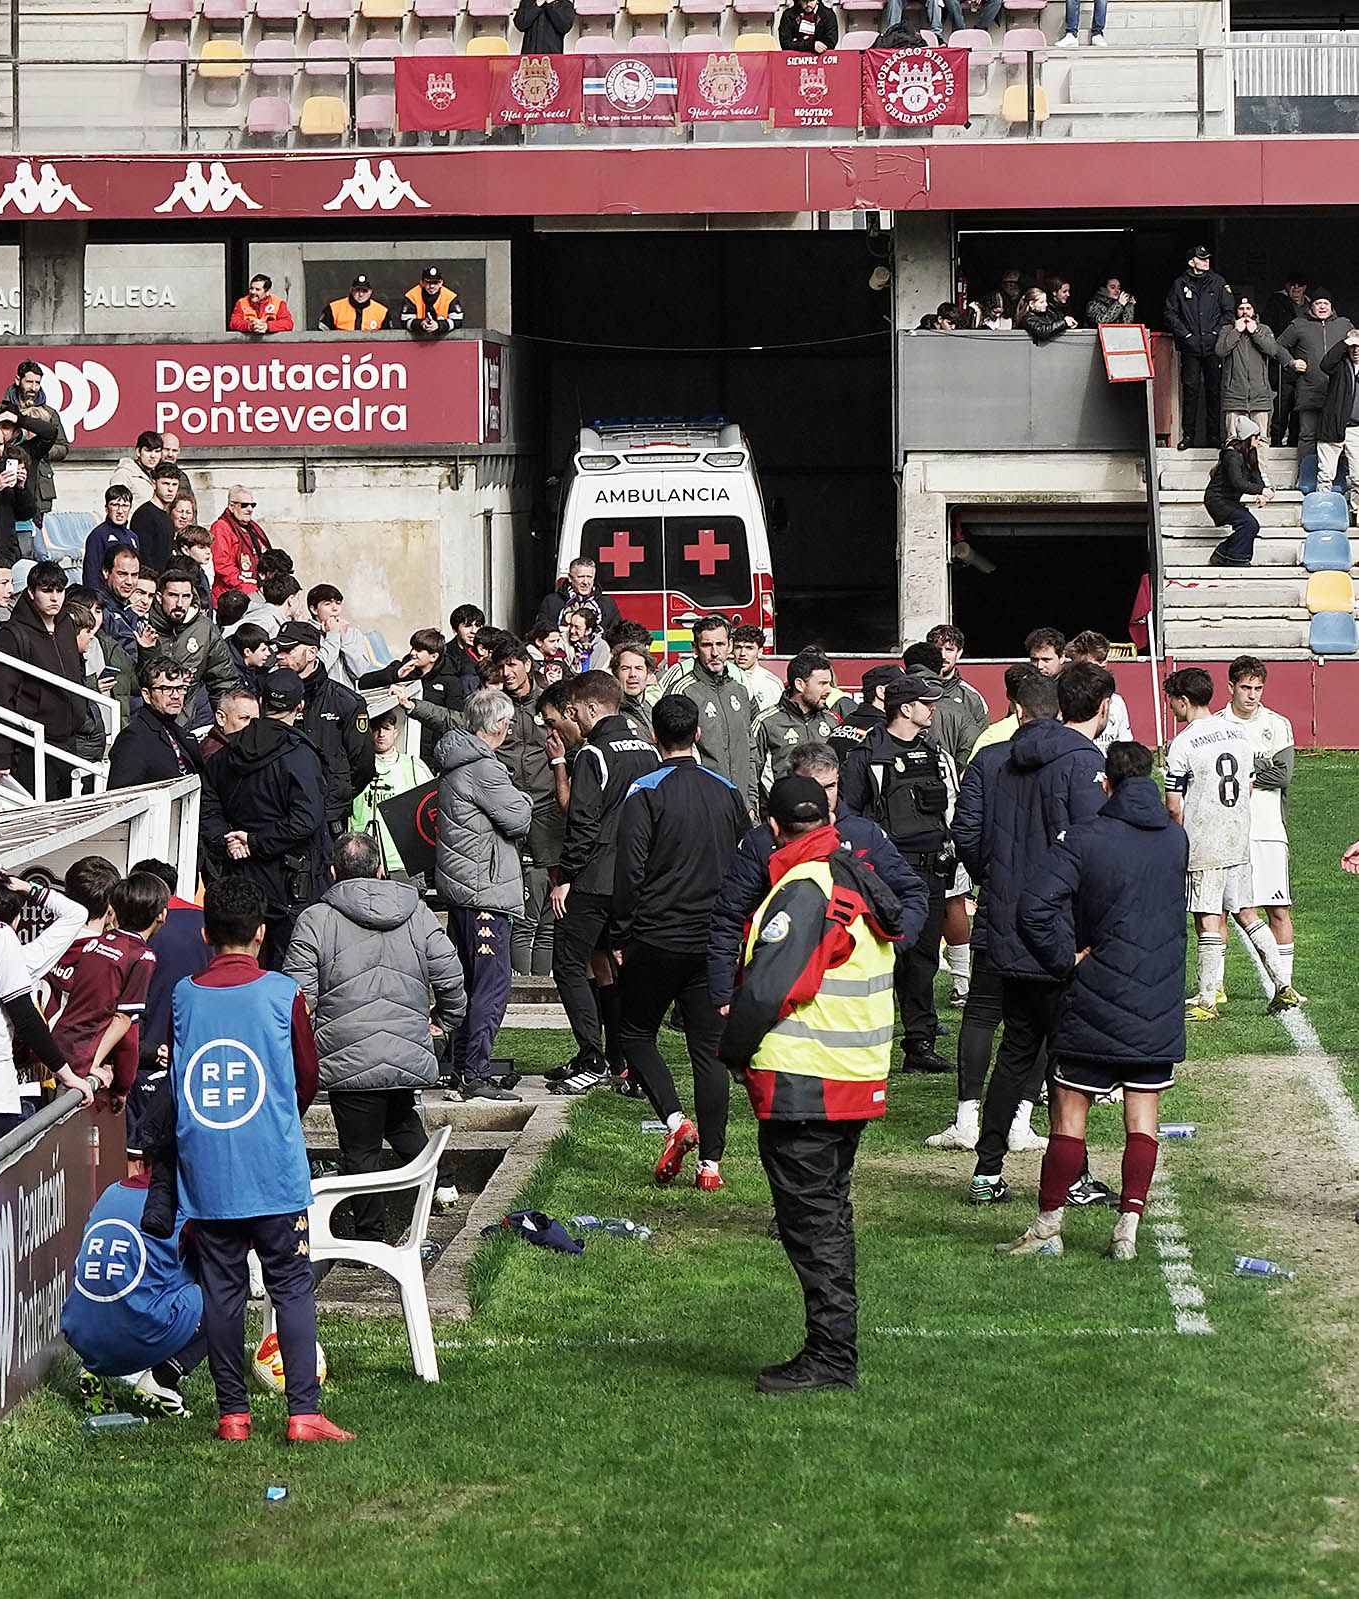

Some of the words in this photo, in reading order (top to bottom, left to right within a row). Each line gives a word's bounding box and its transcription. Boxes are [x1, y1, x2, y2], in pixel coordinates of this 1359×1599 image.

[786, 56, 818, 66] SIEMPRE
[822, 55, 838, 65] CON
[794, 107, 834, 117] NOSOTROS
[155, 353, 408, 403] Deputación
[155, 397, 408, 434] Pontevedra
[595, 488, 730, 503] AMBULANCIA
[1189, 733, 1226, 750] MANUEL
[1215, 752, 1240, 808] 8
[17, 1144, 66, 1281] Deputación
[17, 1257, 67, 1369] Pontevedra
